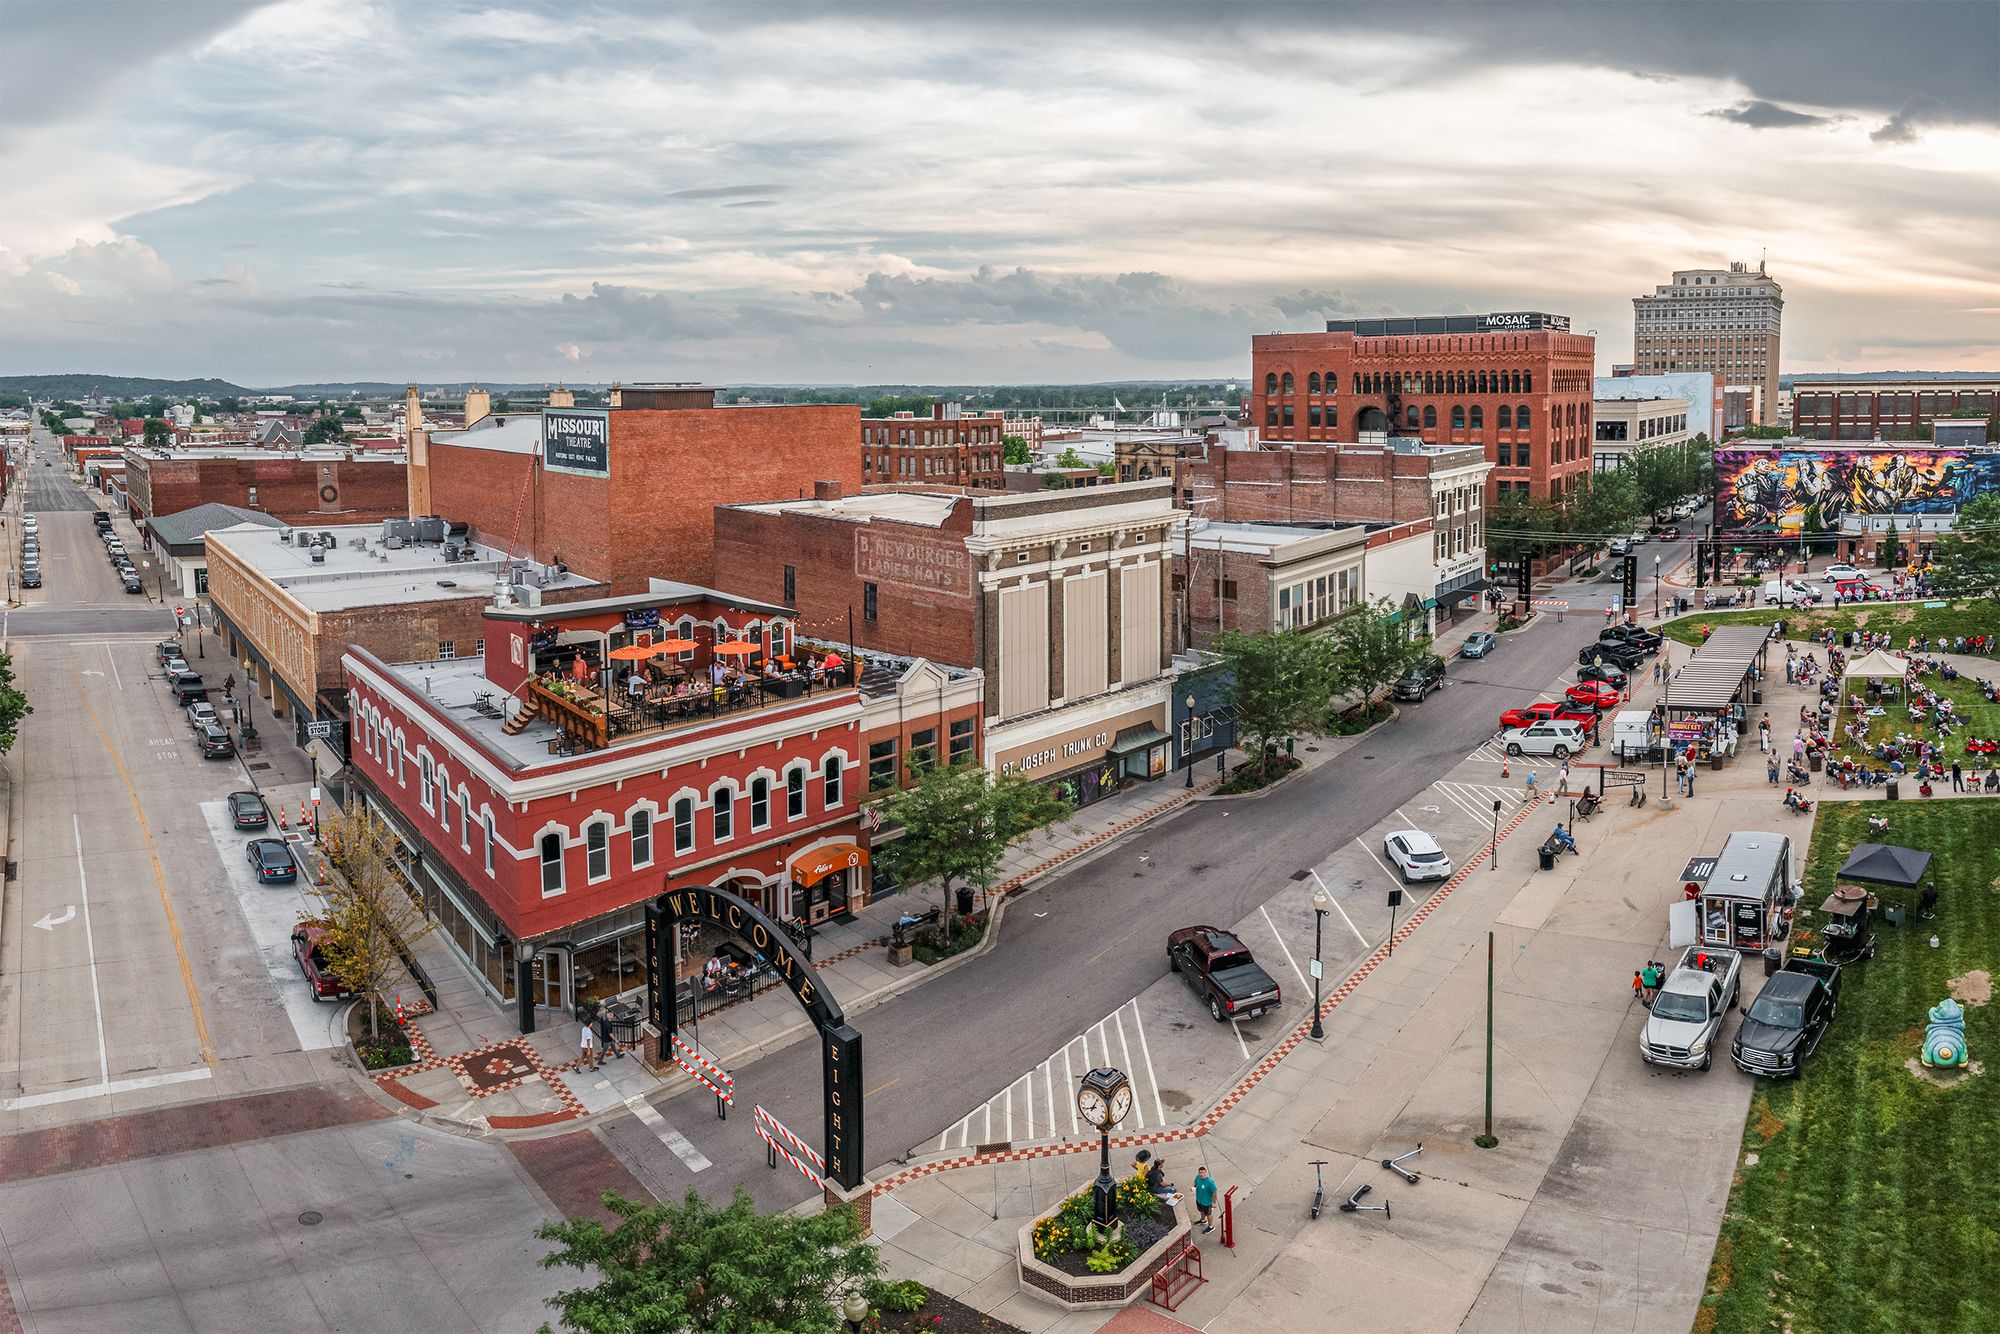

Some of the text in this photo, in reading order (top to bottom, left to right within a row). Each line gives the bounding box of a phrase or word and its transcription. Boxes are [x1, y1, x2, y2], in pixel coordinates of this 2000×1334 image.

[1486, 315, 1530, 326] MOSAIC
[547, 417, 605, 444] MISSOURI
[565, 436, 592, 449] THEATRE
[310, 726, 329, 734] STORE
[149, 738, 175, 746] AHEAD
[1020, 748, 1056, 772] JOSEPH
[1062, 737, 1092, 758] TRUNK
[1095, 732, 1109, 747] CO.
[156, 751, 177, 760] STOP
[669, 892, 815, 1005] WELCOME
[651, 919, 661, 1021] EIGHTH
[831, 1045, 841, 1173] EIGHTH
